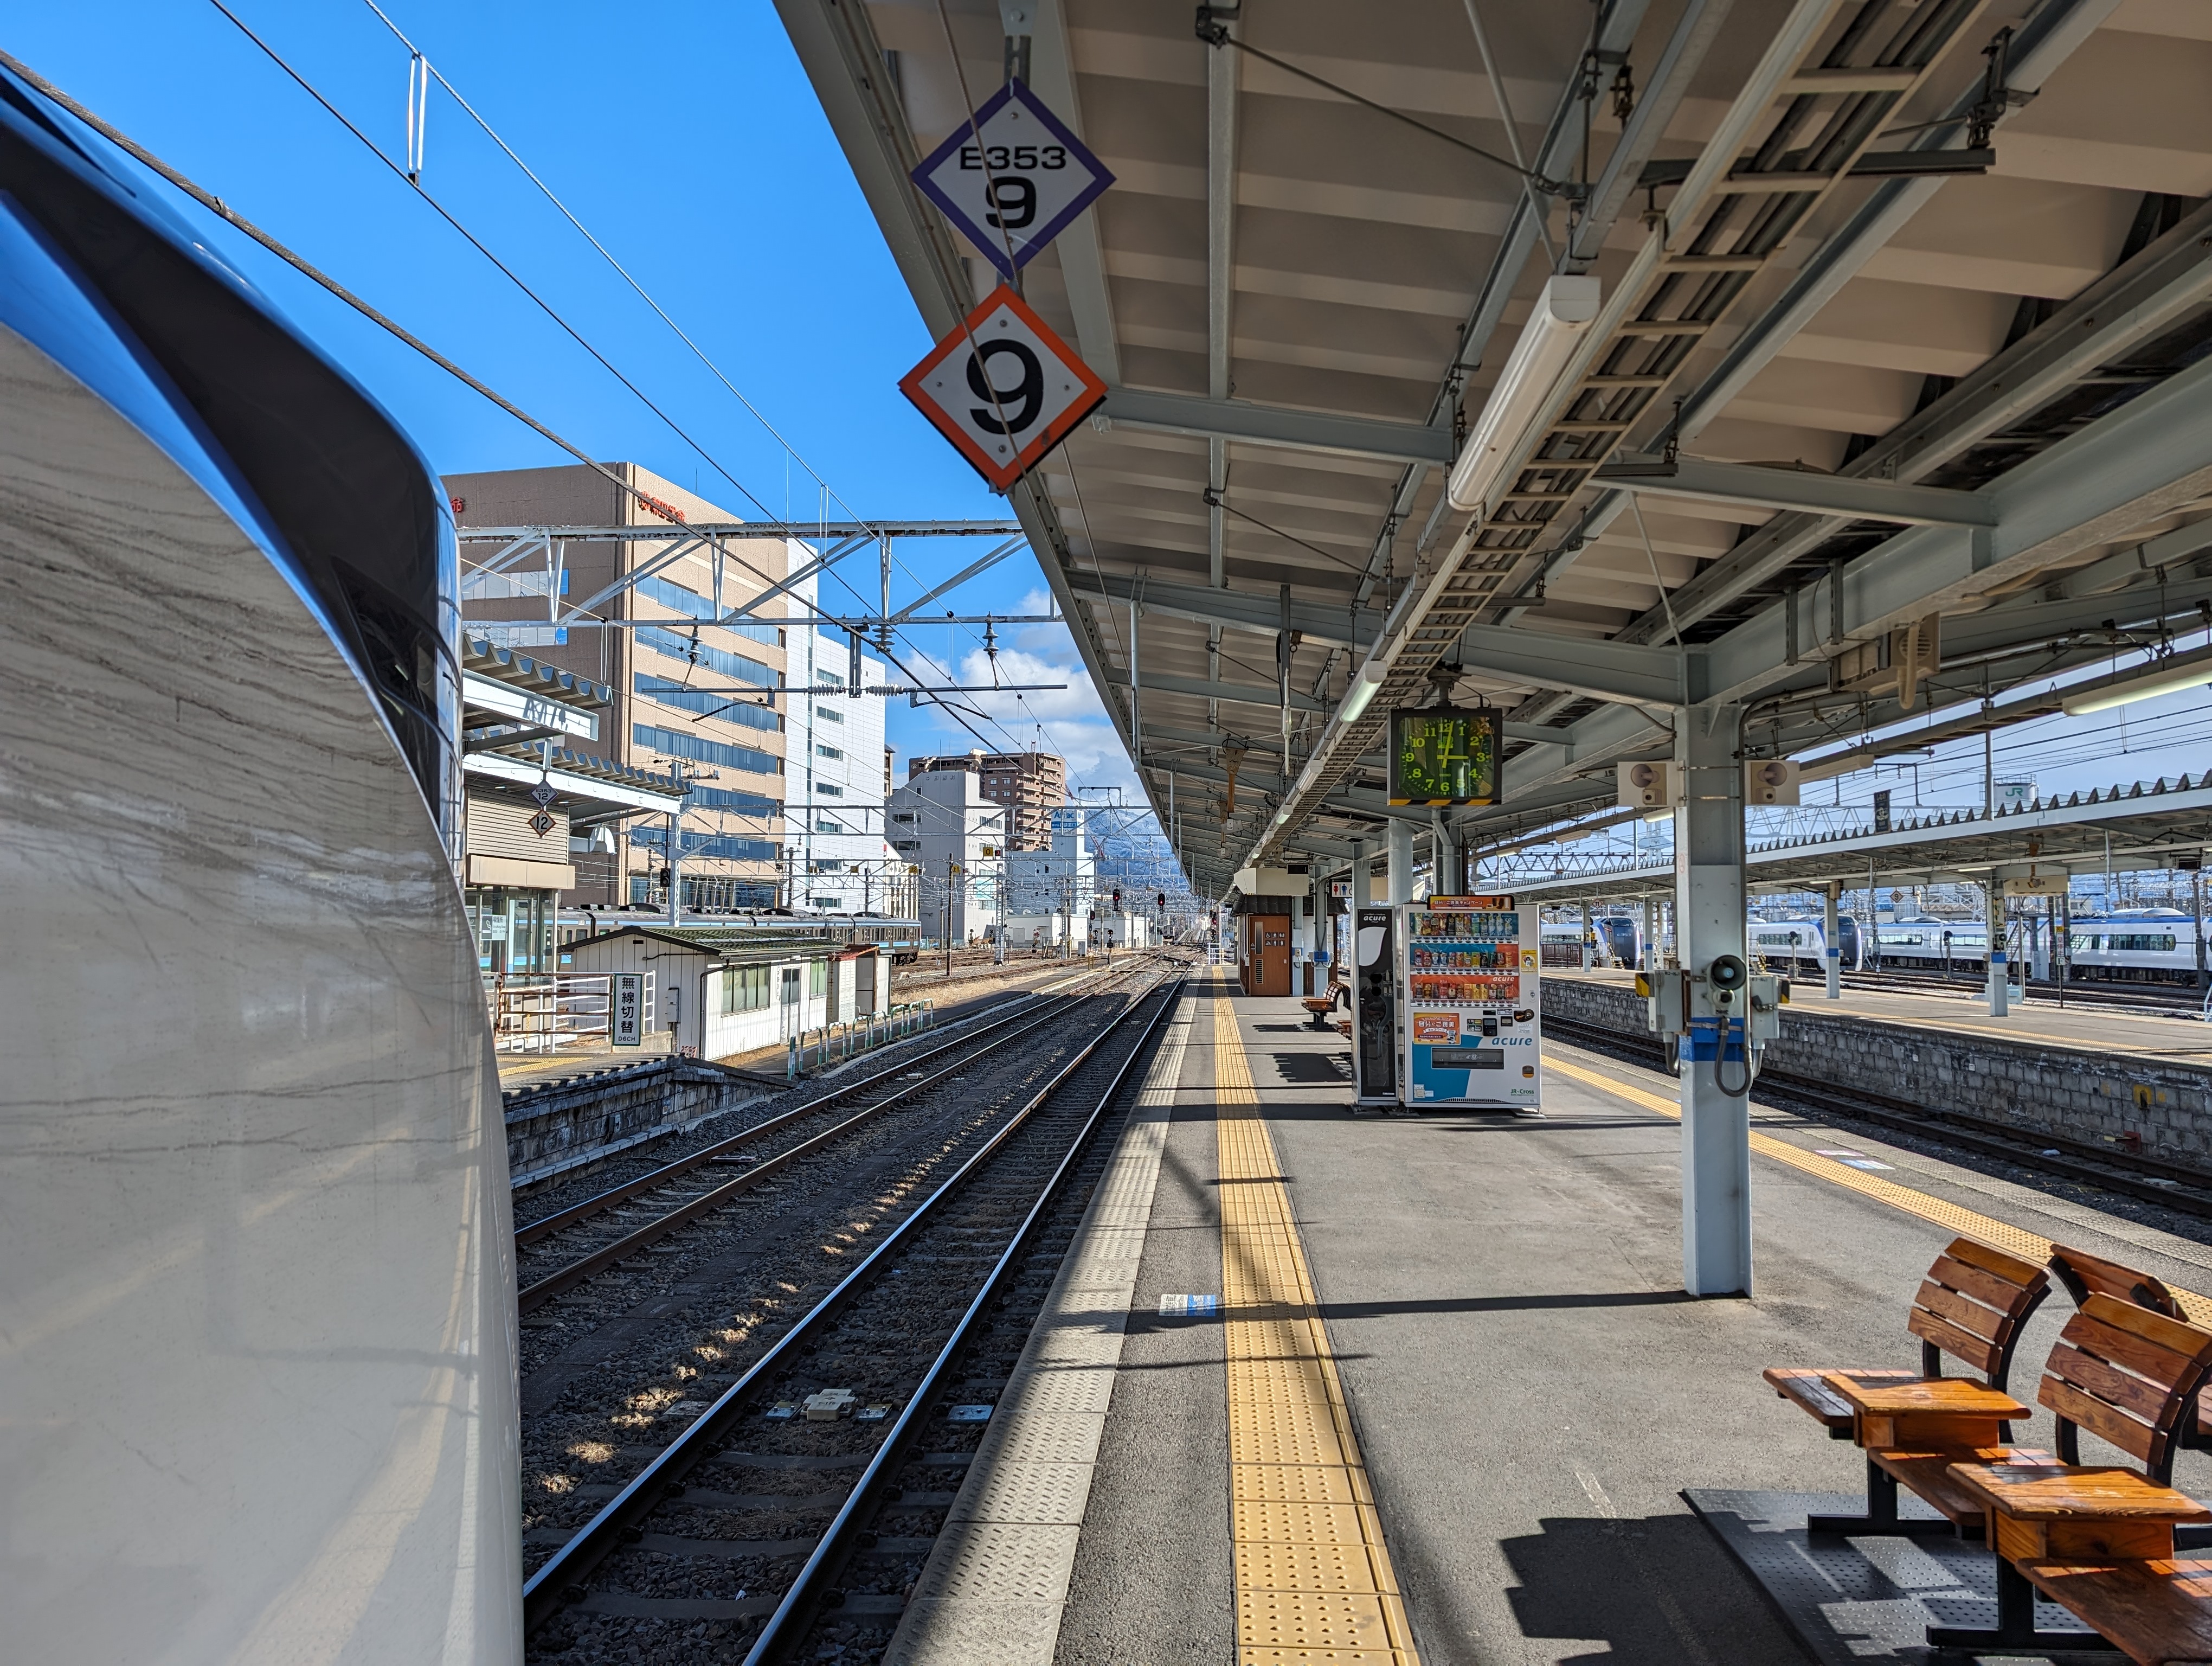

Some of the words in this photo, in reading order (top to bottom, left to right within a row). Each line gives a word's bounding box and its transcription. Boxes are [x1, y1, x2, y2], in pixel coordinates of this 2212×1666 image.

[960, 146, 1067, 171] E353
[985, 176, 1037, 229] 9
[966, 338, 1044, 434] 9
[1425, 728, 1436, 736] 11
[1439, 723, 1452, 732] 12
[1459, 727, 1465, 735] 1
[1412, 738, 1425, 747] 10
[1470, 736, 1480, 746] 2
[1405, 753, 1414, 762] 9
[1476, 753, 1486, 761] 3
[1412, 768, 1422, 778] 8
[1468, 769, 1478, 778] 4
[1426, 779, 1435, 788] 7
[1441, 782, 1450, 792] 6
[1457, 779, 1465, 788] 5
[2005, 787, 2023, 796] JR
[536, 816, 548, 829] 12
[621, 977, 635, 1033] 無線切替
[1491, 1037, 1533, 1046] acure
